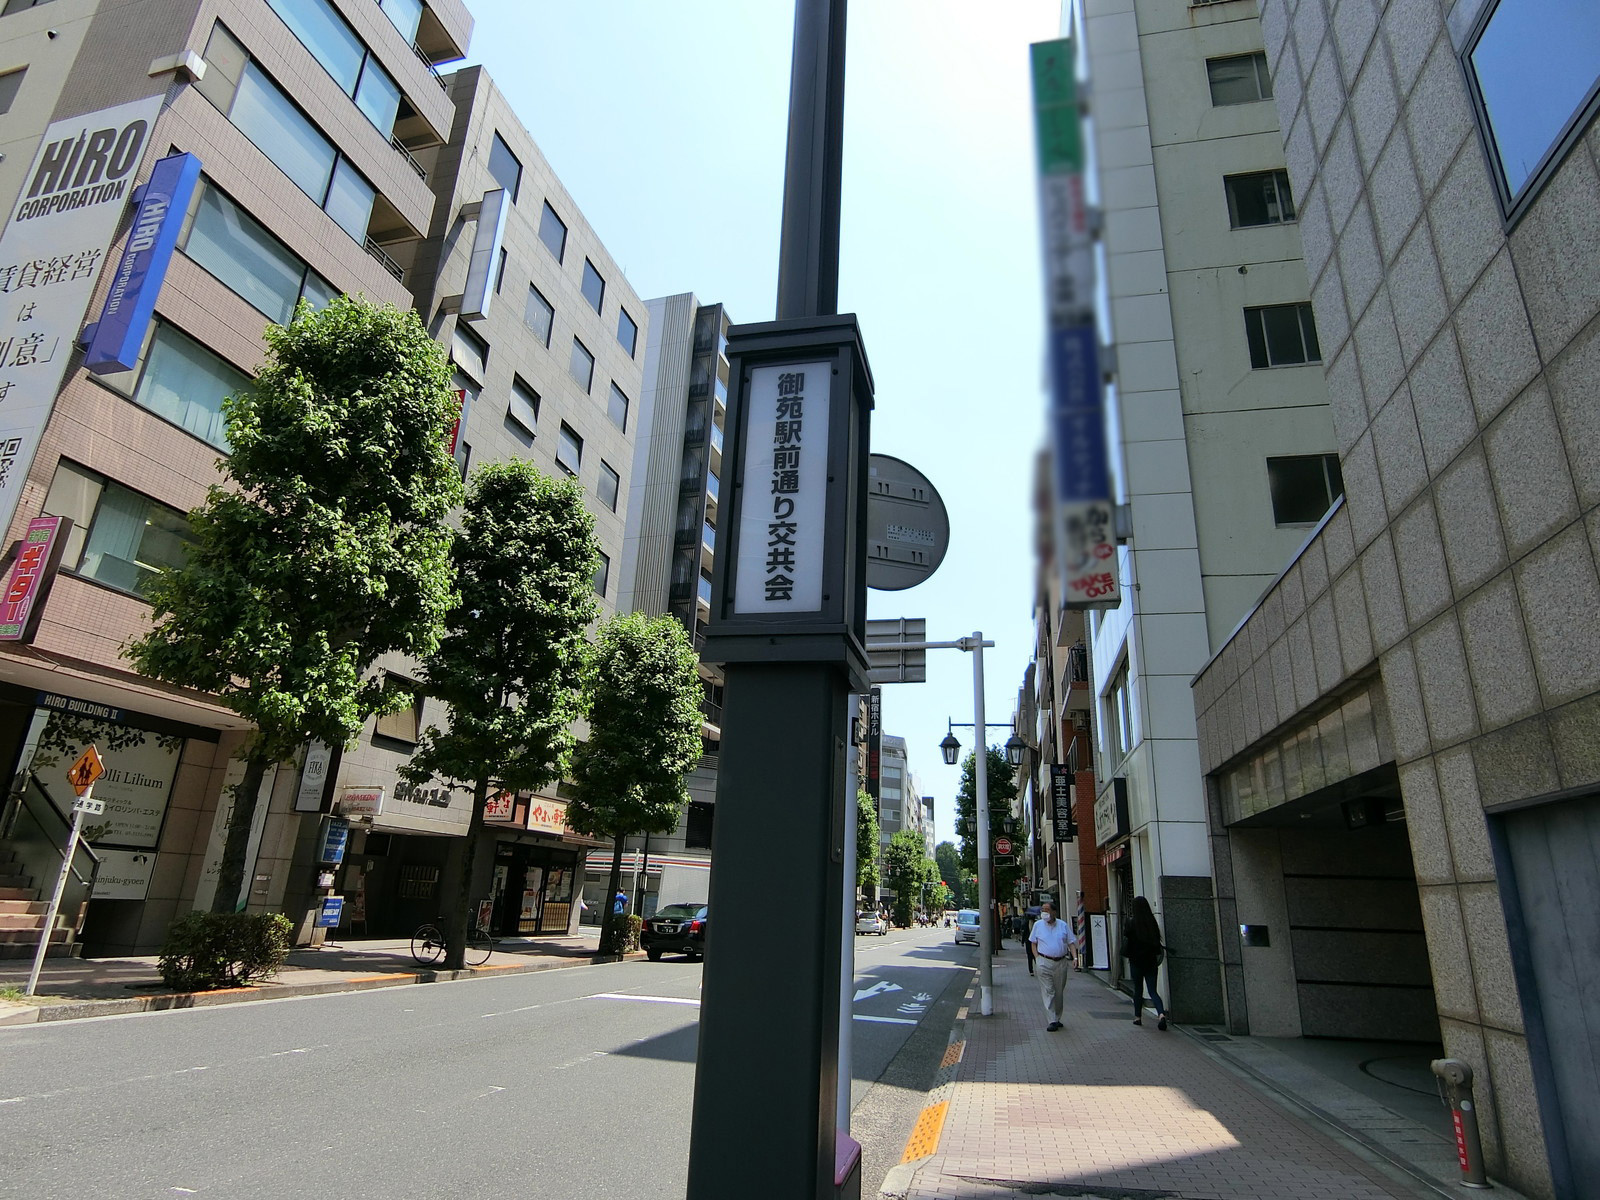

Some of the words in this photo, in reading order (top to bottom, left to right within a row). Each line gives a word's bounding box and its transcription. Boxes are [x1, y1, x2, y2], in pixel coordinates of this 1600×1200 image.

[26, 119, 148, 199] HIRO
[16, 179, 128, 222] CORPORATION
[130, 202, 167, 252] HIRO
[106, 253, 136, 315] CORPORATION
[16, 302, 37, 322] は
[764, 372, 805, 602] 御苑駅前通り交共会
[1068, 572, 1113, 591] TAKE
[1086, 582, 1114, 598] OUT
[44, 694, 67, 708] HIRO
[68, 700, 110, 718] BUILDING
[870, 695, 880, 736] 新宿ホテル
[123, 771, 164, 788] Lilium
[76, 799, 102, 812] 通学路
[1055, 775, 1068, 830] 亜土美容室
